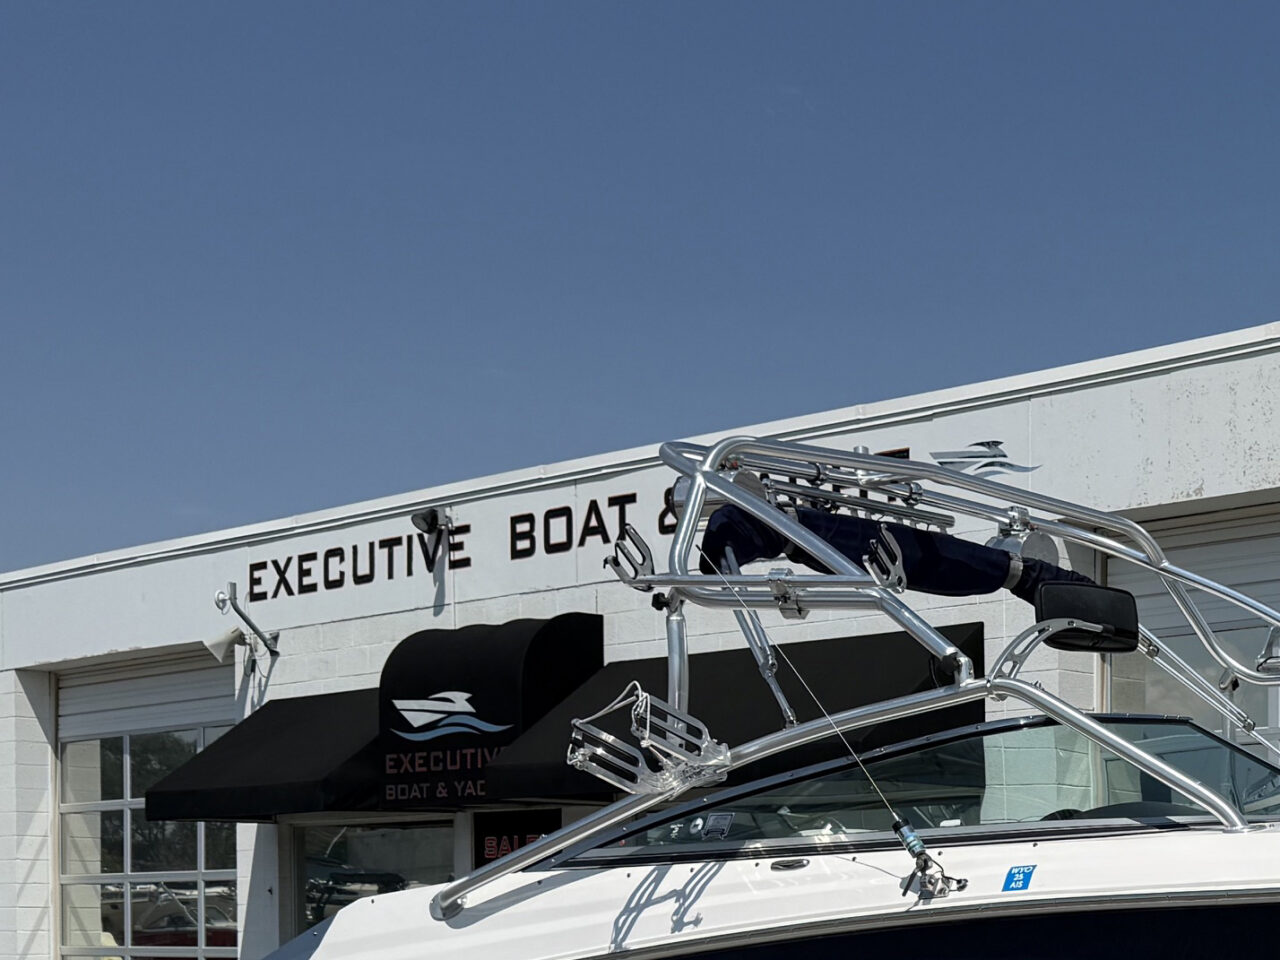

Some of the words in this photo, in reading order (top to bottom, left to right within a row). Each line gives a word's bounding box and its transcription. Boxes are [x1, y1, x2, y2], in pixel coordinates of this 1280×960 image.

[249, 524, 471, 603] EXECUTIVE
[510, 492, 637, 560] BOAT
[385, 747, 505, 774] EXECUTIV
[385, 783, 430, 800] BOAT
[436, 782, 448, 797] &
